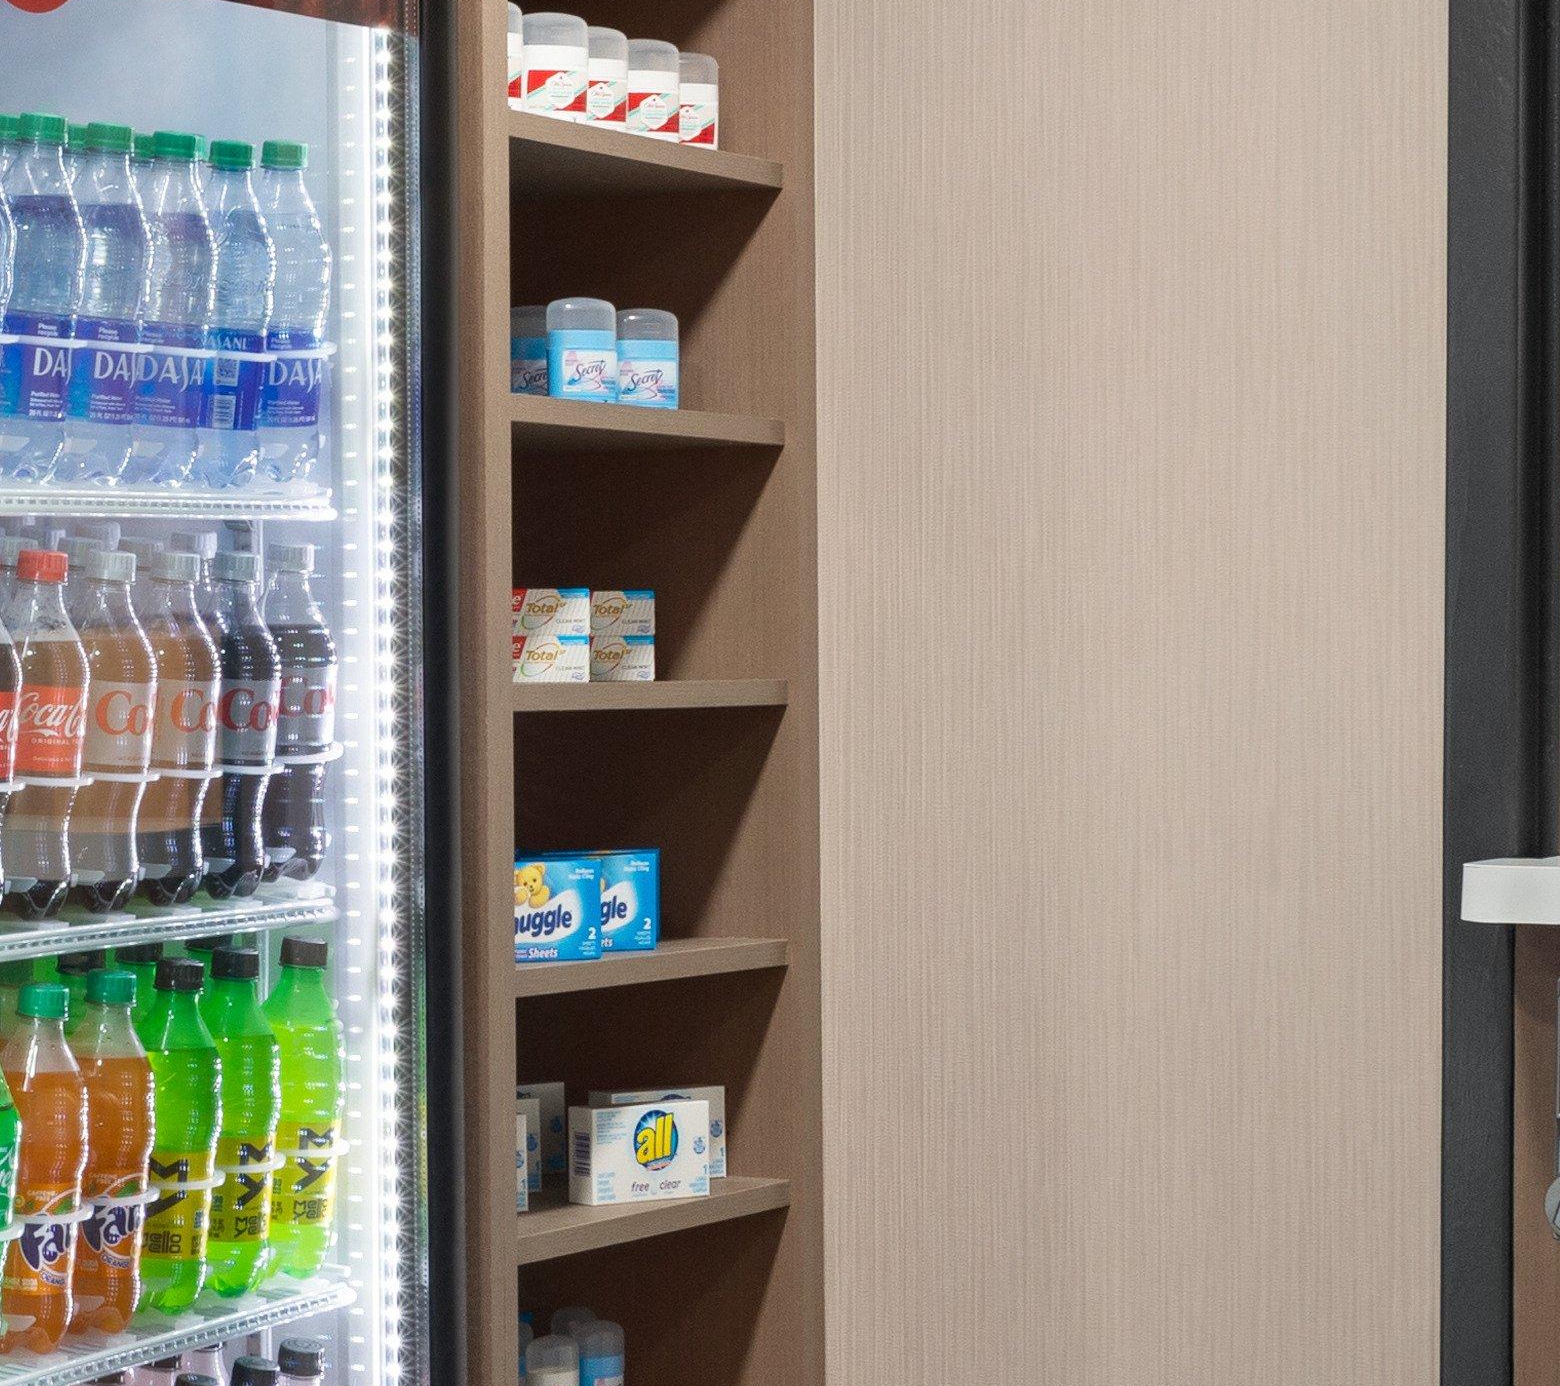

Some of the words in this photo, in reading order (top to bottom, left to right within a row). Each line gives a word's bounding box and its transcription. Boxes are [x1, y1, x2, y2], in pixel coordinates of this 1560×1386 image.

[575, 359, 606, 384] Secret
[631, 369, 664, 394] Secret
[526, 601, 559, 615] Total
[593, 603, 624, 616] Total
[526, 649, 559, 662] Total
[593, 649, 625, 662] Total
[587, 926, 597, 940] 2
[636, 1113, 675, 1165] all
[631, 1180, 650, 1193] free
[659, 1179, 681, 1191] clear
